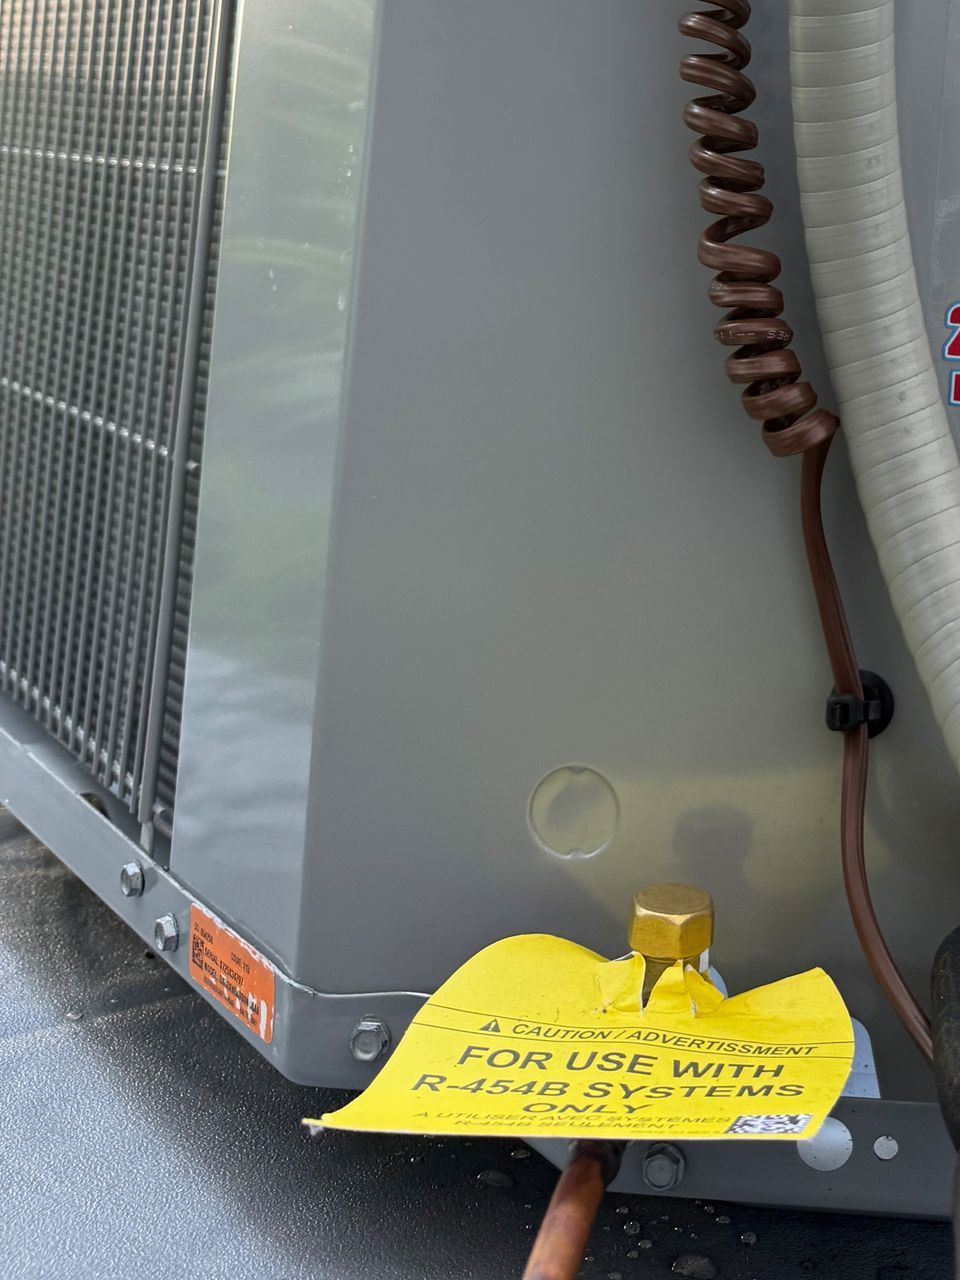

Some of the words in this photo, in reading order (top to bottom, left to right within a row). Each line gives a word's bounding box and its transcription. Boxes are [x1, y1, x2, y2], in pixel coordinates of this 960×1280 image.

[512, 1023, 611, 1040] CAUTION
[626, 1030, 818, 1056] ADVERTISSMENT
[457, 1045, 553, 1070] FOR
[566, 1051, 658, 1076] USE
[672, 1060, 784, 1078] WITH
[411, 1074, 570, 1097] R-454B
[583, 1082, 805, 1100] SYSTEMS
[522, 1103, 652, 1114] ONLY
